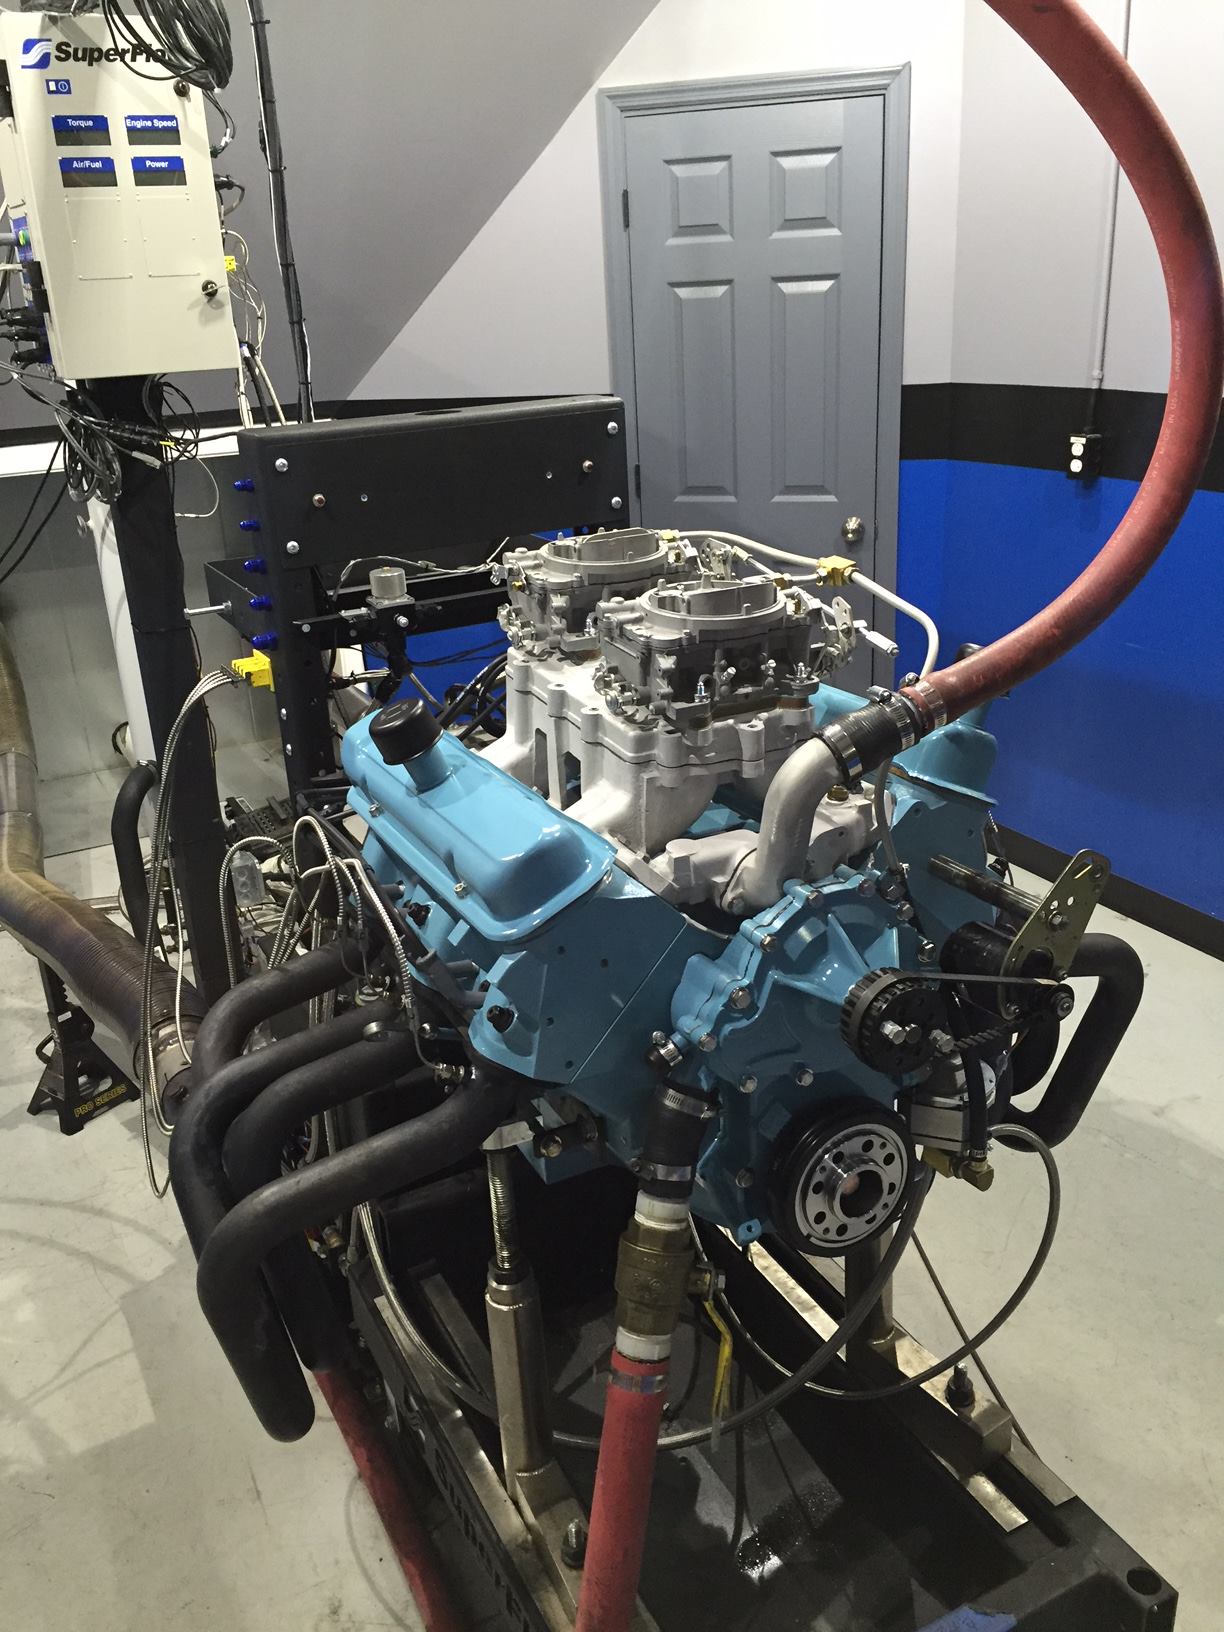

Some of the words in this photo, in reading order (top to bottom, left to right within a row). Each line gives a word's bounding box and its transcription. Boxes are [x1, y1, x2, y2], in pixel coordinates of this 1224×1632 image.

[67, 118, 94, 127] Torque
[126, 119, 152, 128] Engine
[154, 119, 177, 128] Speed
[72, 160, 103, 168] Air/Fuel
[145, 160, 169, 168] Power
[74, 1101, 95, 1118] PRO
